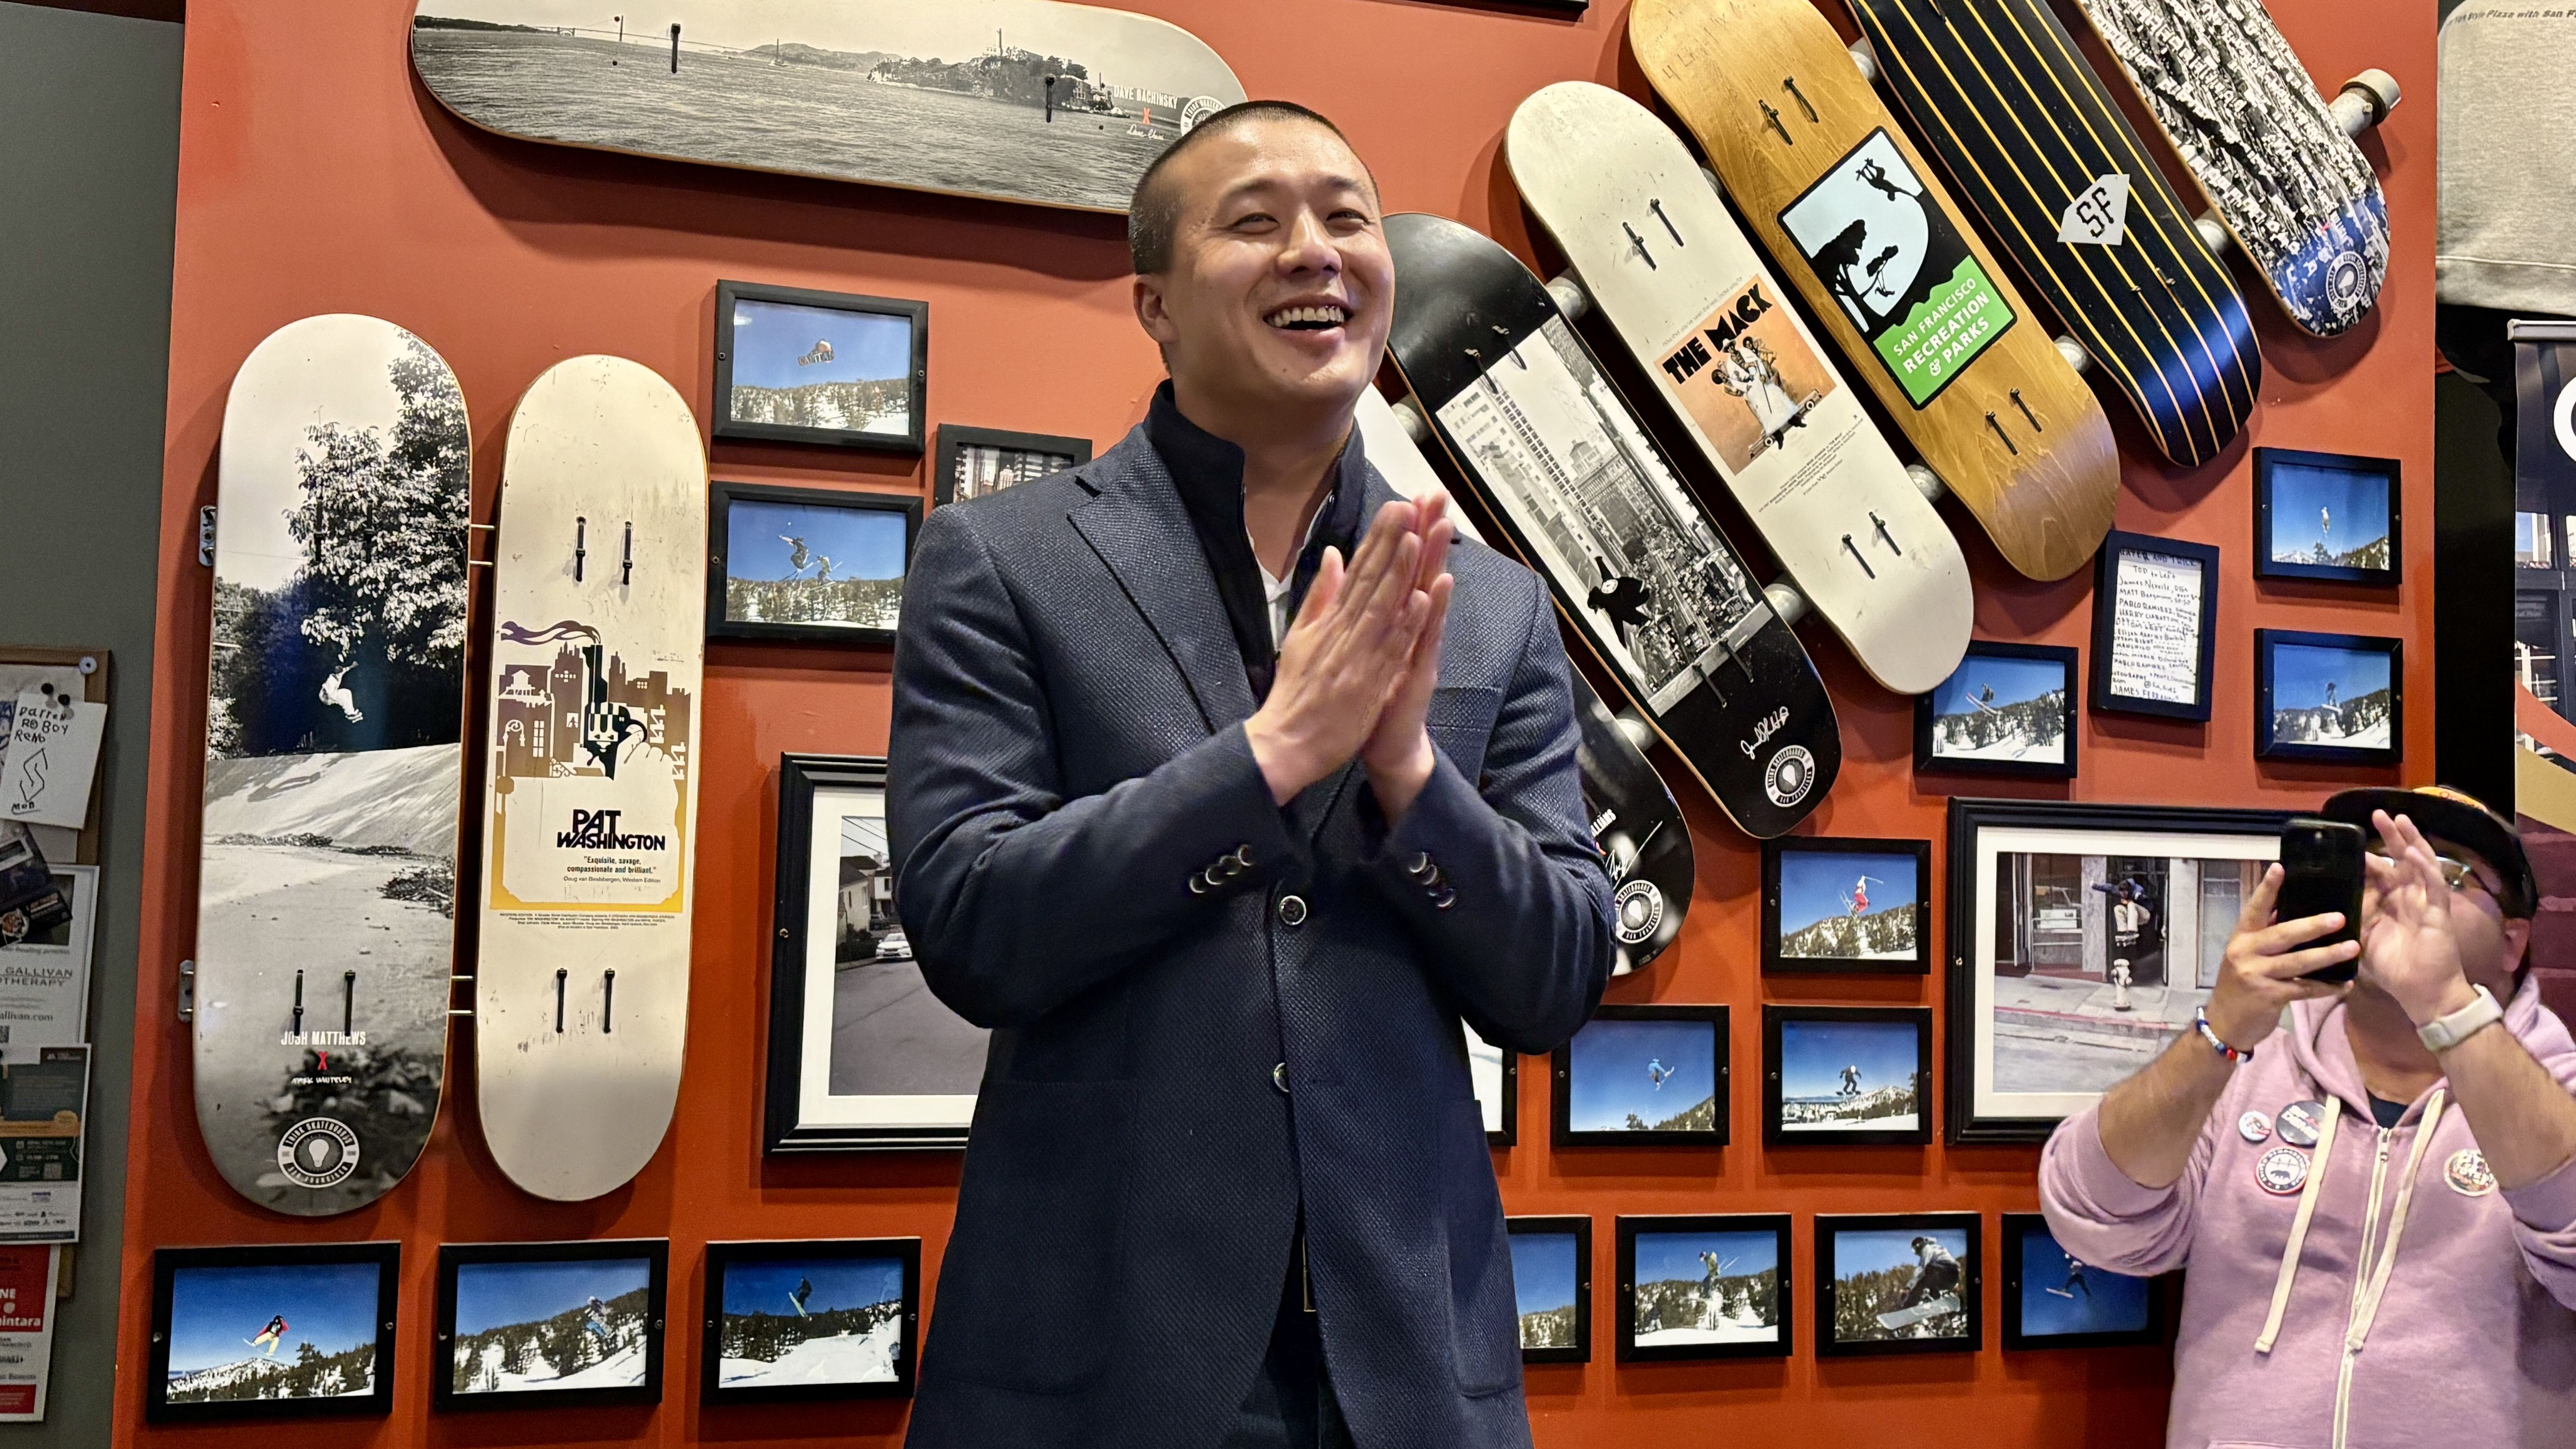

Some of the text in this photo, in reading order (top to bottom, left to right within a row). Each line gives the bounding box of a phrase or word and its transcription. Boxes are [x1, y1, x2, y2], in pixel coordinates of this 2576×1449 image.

[2486, 10, 2515, 18] Pizza
[2517, 10, 2539, 18] with
[1113, 85, 1178, 110] DAVE BACHINSKY
[2076, 187, 2115, 238] SF
[1893, 278, 1976, 356] SAN FRANCISCO
[1662, 283, 1773, 385] THE MACK
[1903, 290, 1989, 374] RECREATION
[1929, 316, 1989, 377] & PARKS
[572, 809, 621, 834] PAT
[557, 832, 666, 851] WASHINGTON
[567, 865, 613, 874] compassionate
[0, 977, 65, 987] THERAPY
[5, 966, 73, 978] GALLIVAN
[281, 1031, 366, 1045] JOSH MATTHEWS
[285, 1121, 353, 1145] THINK SKATEBOARDS
